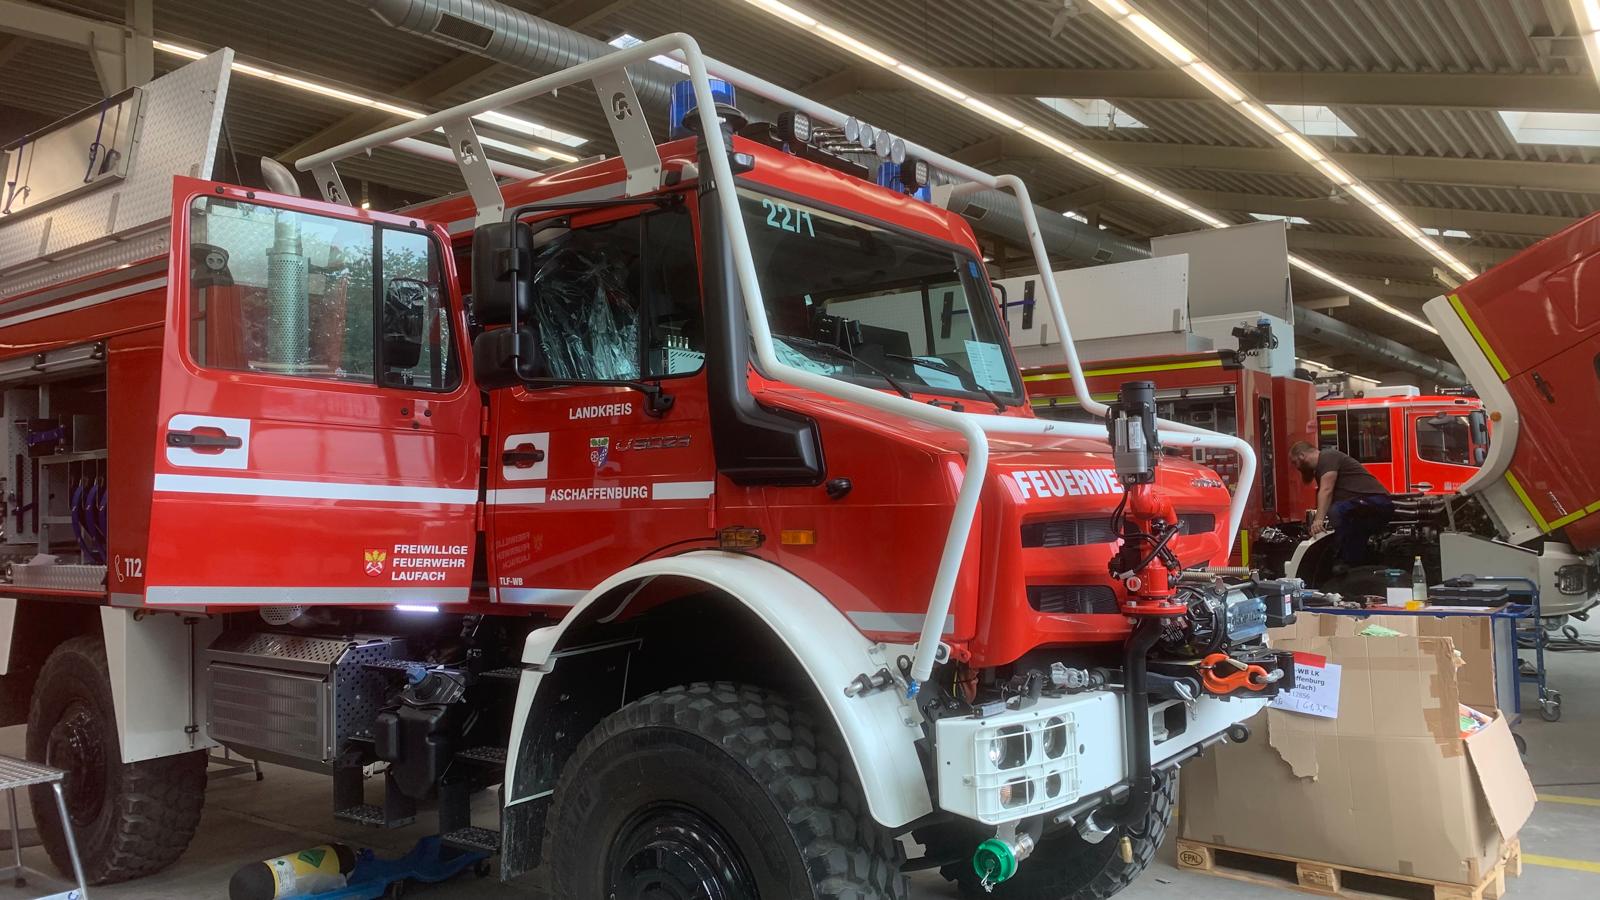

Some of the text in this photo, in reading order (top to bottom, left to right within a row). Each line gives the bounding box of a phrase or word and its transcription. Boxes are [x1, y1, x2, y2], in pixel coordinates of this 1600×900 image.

[762, 198, 816, 238] 22/1
[569, 402, 633, 420] LANDKREIS
[1011, 468, 1125, 499] FEUERWE
[549, 485, 648, 502] ASCHAFFENBURG
[393, 544, 469, 555] FREIWILLIGE
[124, 557, 143, 578] 112
[392, 557, 466, 568] FEUERWEHR
[391, 571, 446, 581] LAUFACH
[498, 576, 524, 586] TLF-WB
[1310, 669, 1320, 677] LK
[1295, 675, 1325, 687] ffenburg
[1295, 683, 1317, 693] ufach)
[1183, 853, 1199, 863] EPAL
